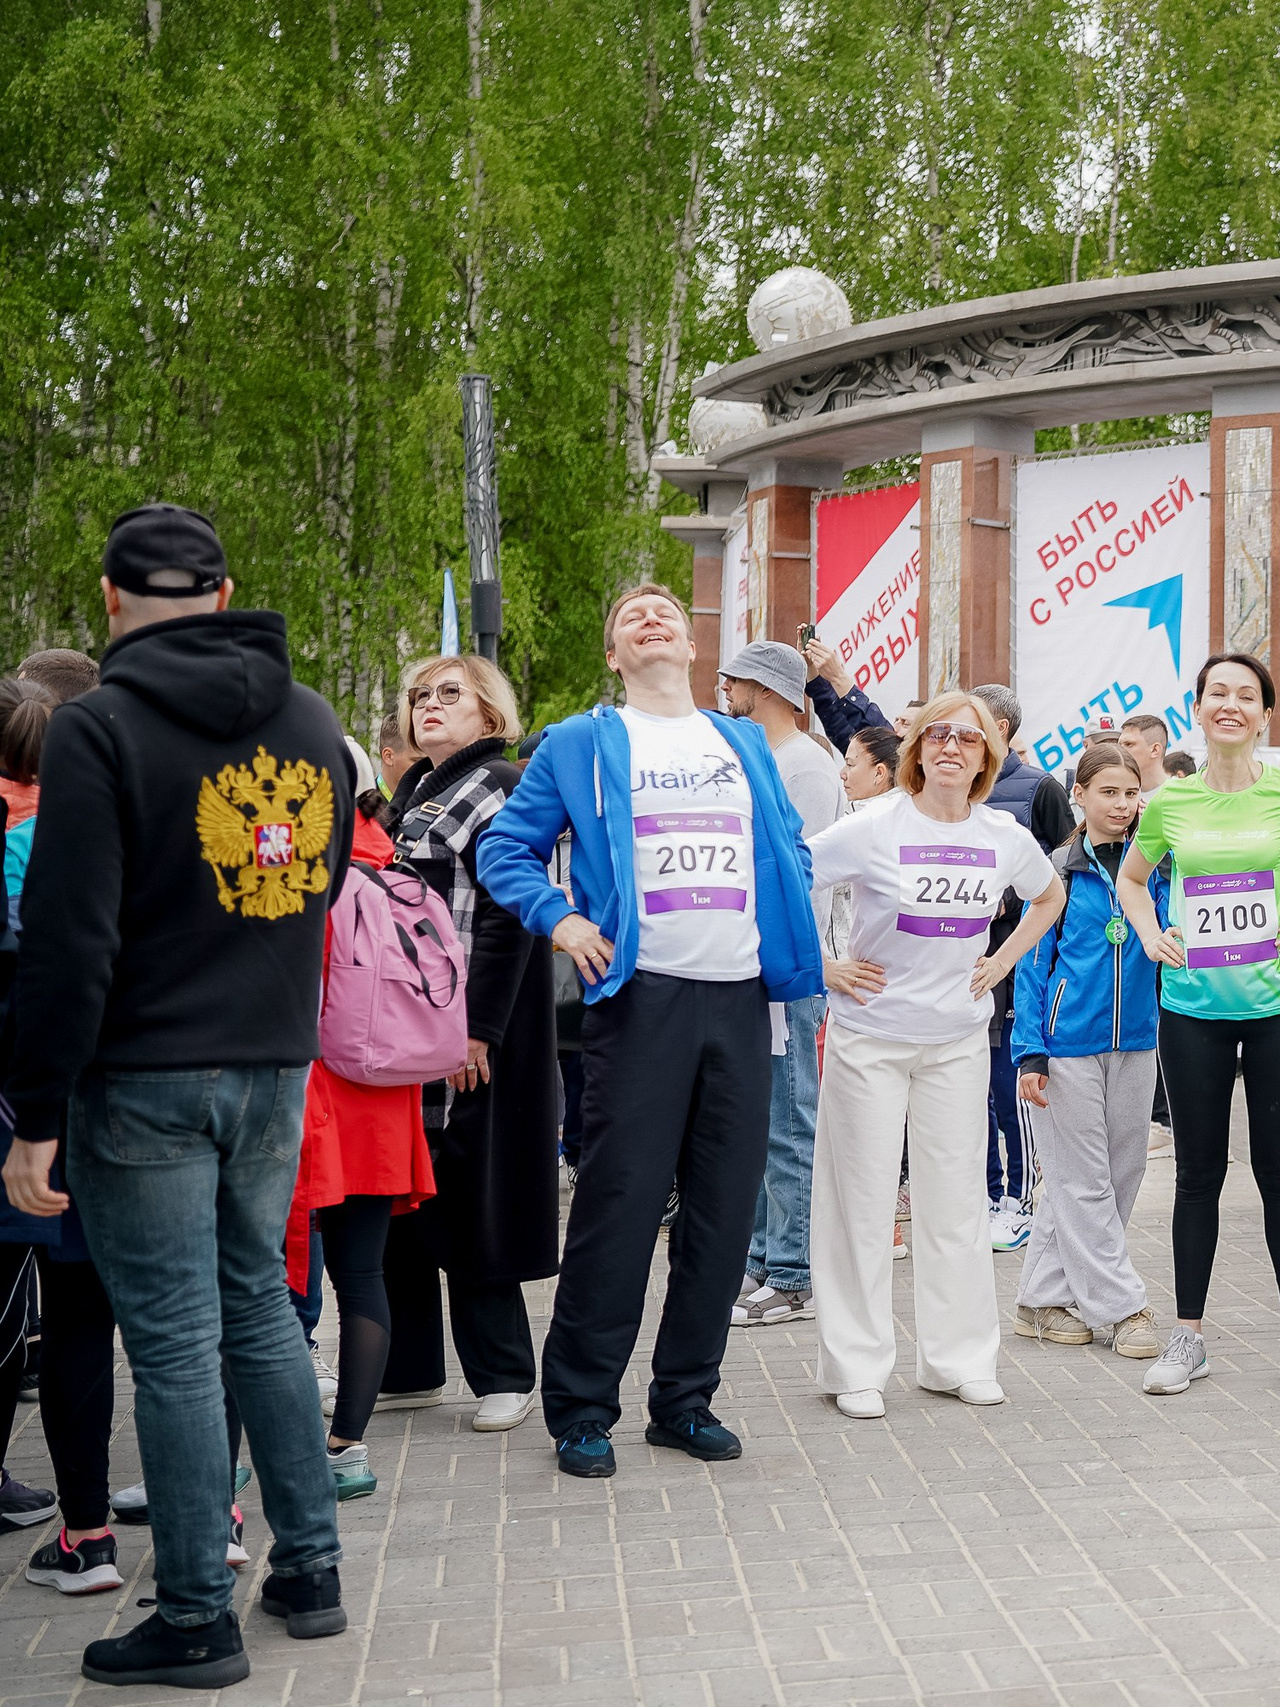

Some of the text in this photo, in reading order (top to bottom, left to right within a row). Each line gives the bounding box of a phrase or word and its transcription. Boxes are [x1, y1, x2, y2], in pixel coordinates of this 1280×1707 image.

[1029, 474, 1195, 626] С РОССИЕЙ
[1036, 499, 1118, 573] БЫТЬ
[833, 549, 919, 664] ВИЖЕНИЕ
[1032, 681, 1144, 772] БЫТЬ
[655, 845, 739, 875] 2072
[916, 876, 988, 905] 2244
[1197, 902, 1268, 934] 2100
